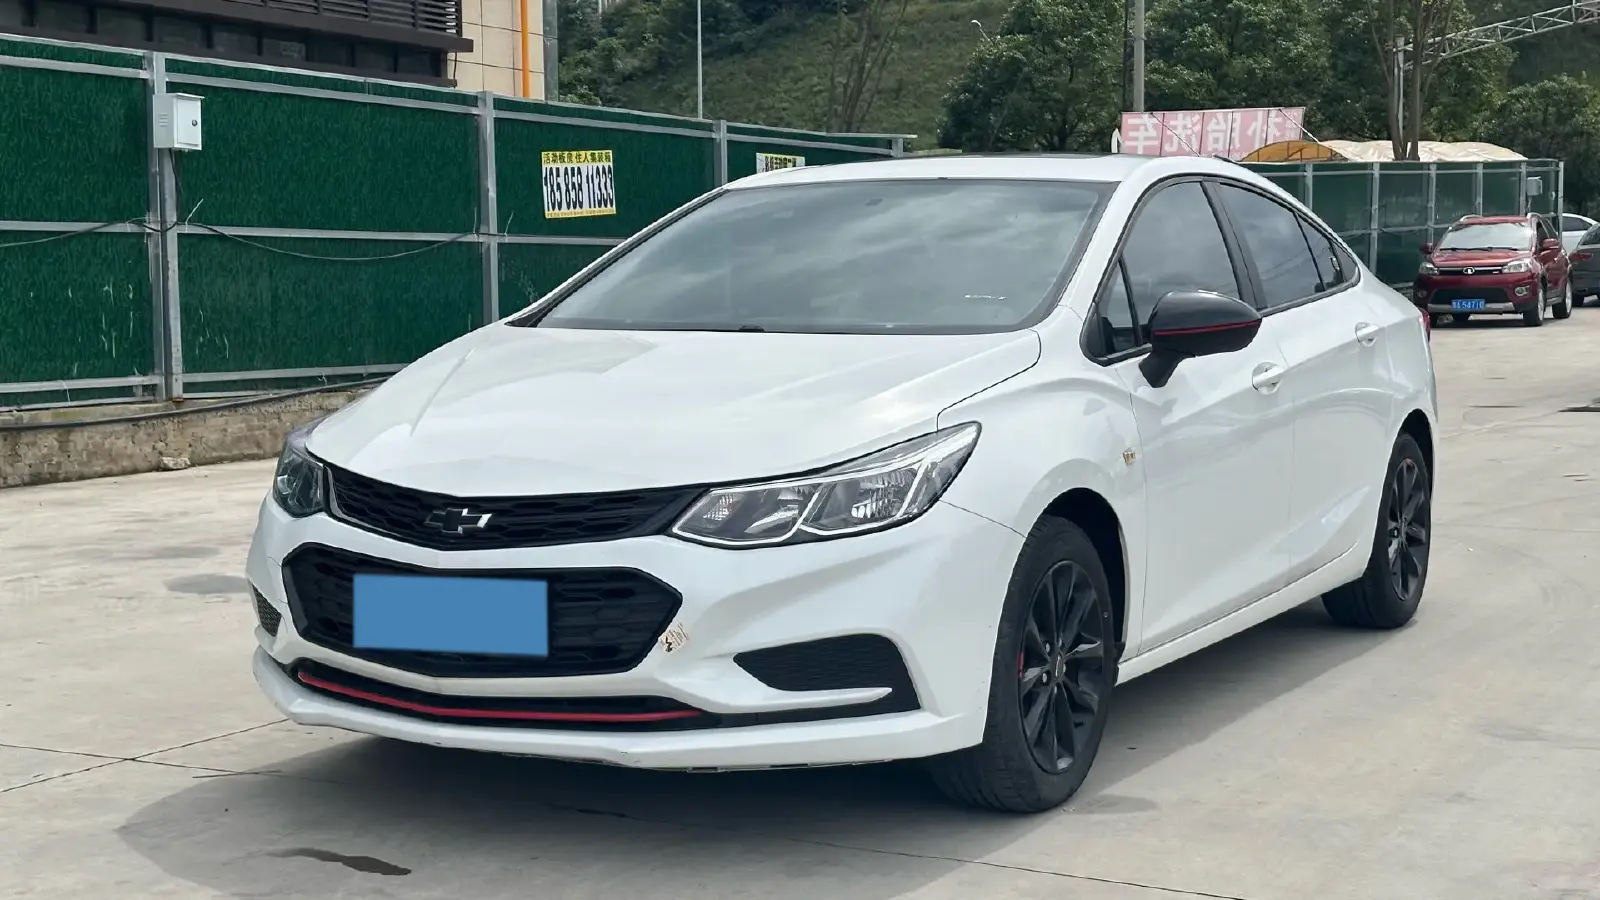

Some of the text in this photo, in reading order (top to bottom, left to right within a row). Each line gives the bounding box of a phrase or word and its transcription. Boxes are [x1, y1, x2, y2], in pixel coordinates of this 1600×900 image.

[544, 165, 613, 212] 185 858 11333
